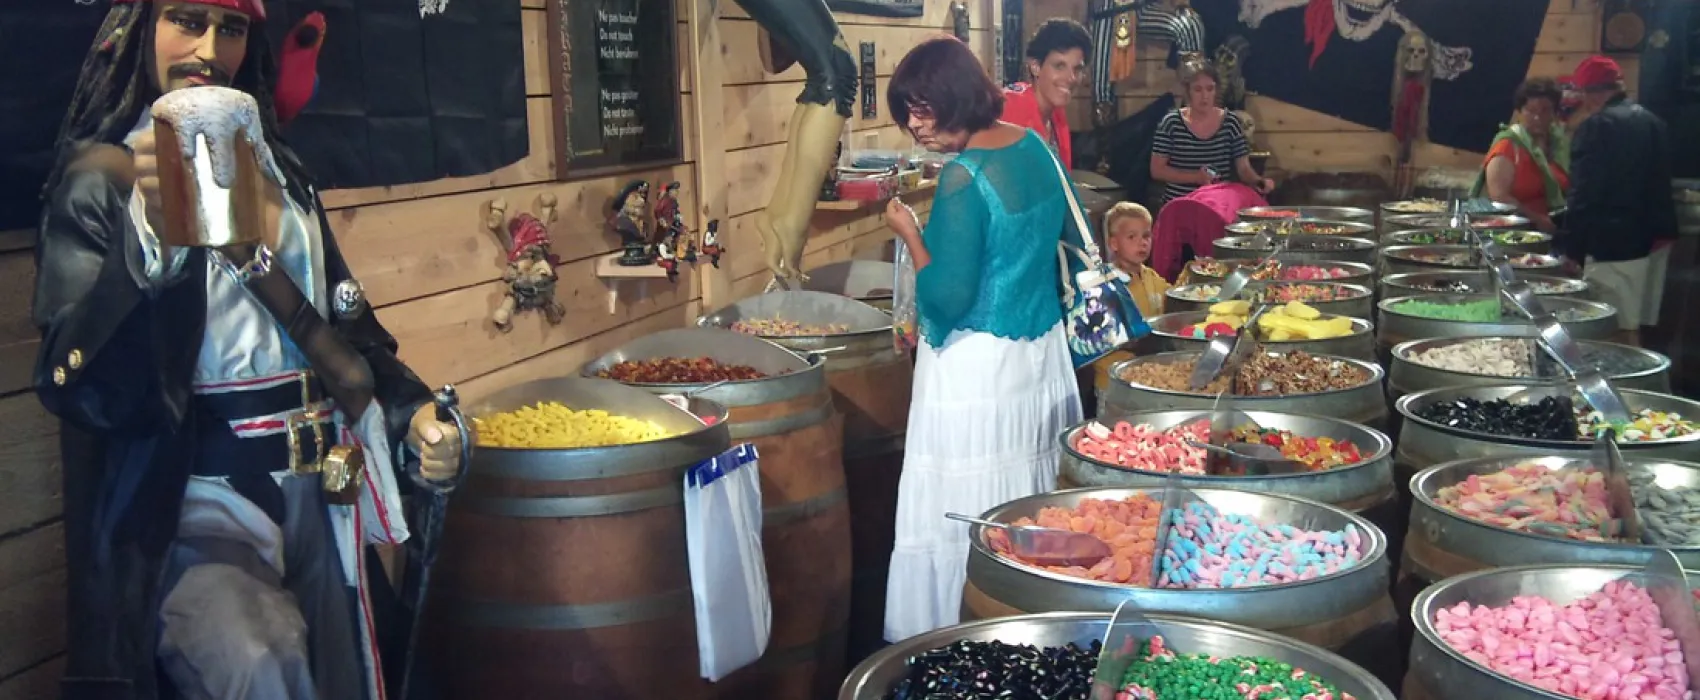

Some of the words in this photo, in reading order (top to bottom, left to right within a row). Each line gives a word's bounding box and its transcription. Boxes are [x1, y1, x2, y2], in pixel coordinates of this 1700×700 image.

[599, 9, 608, 22] Ne
[609, 13, 618, 25] pas
[600, 27, 608, 40] Do
[609, 29, 617, 40] not
[618, 28, 632, 41] touch
[601, 45, 614, 58] Nicht
[601, 88, 611, 101] Ne
[612, 92, 620, 104] pas
[603, 106, 611, 119] Do
[612, 108, 620, 119] not
[604, 123, 618, 136] Nicht
